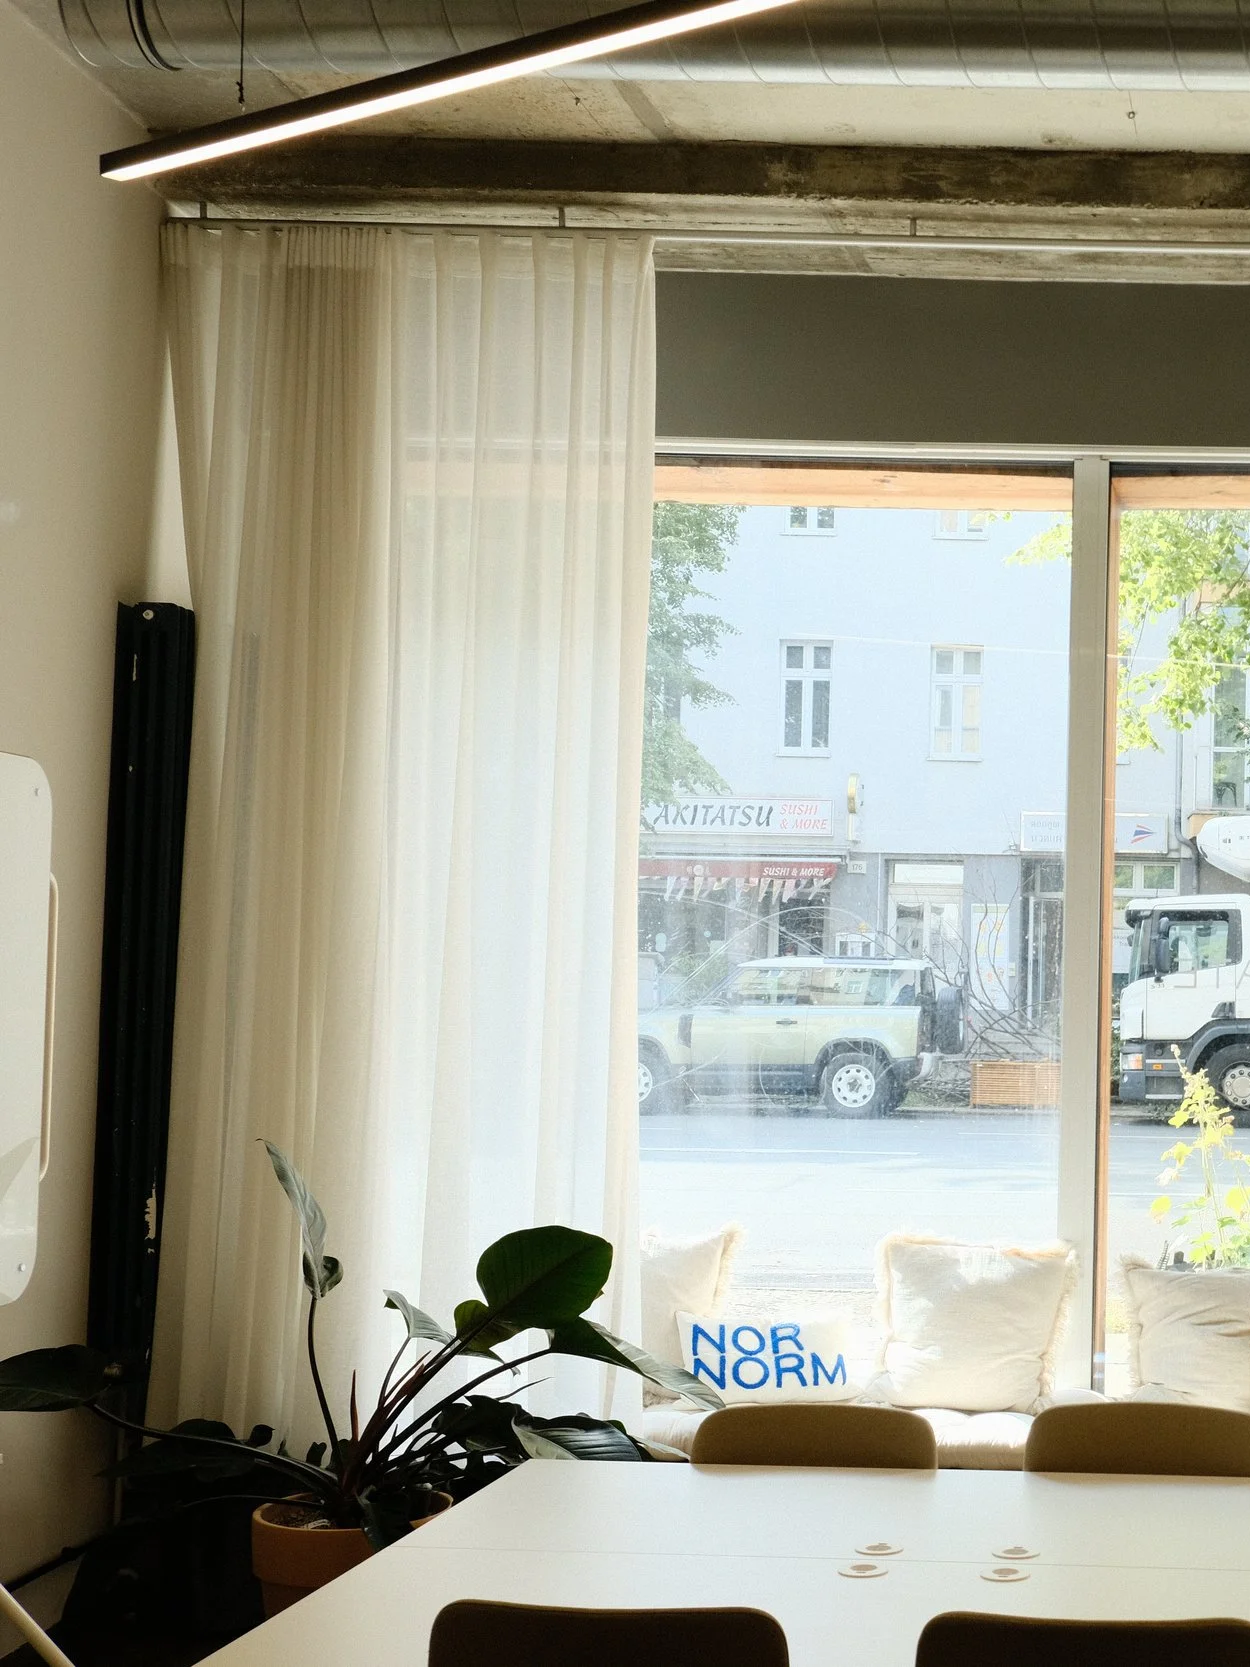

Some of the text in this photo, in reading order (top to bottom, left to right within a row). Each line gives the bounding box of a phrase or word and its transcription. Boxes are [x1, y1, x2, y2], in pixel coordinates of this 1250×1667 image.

[653, 803, 774, 828] AKITATSU
[779, 803, 819, 816] SUSHI
[780, 818, 828, 830] & MORE
[762, 867, 825, 877] SUSHI & MORE
[692, 1322, 805, 1357] NOR
[693, 1352, 847, 1390] NORM
